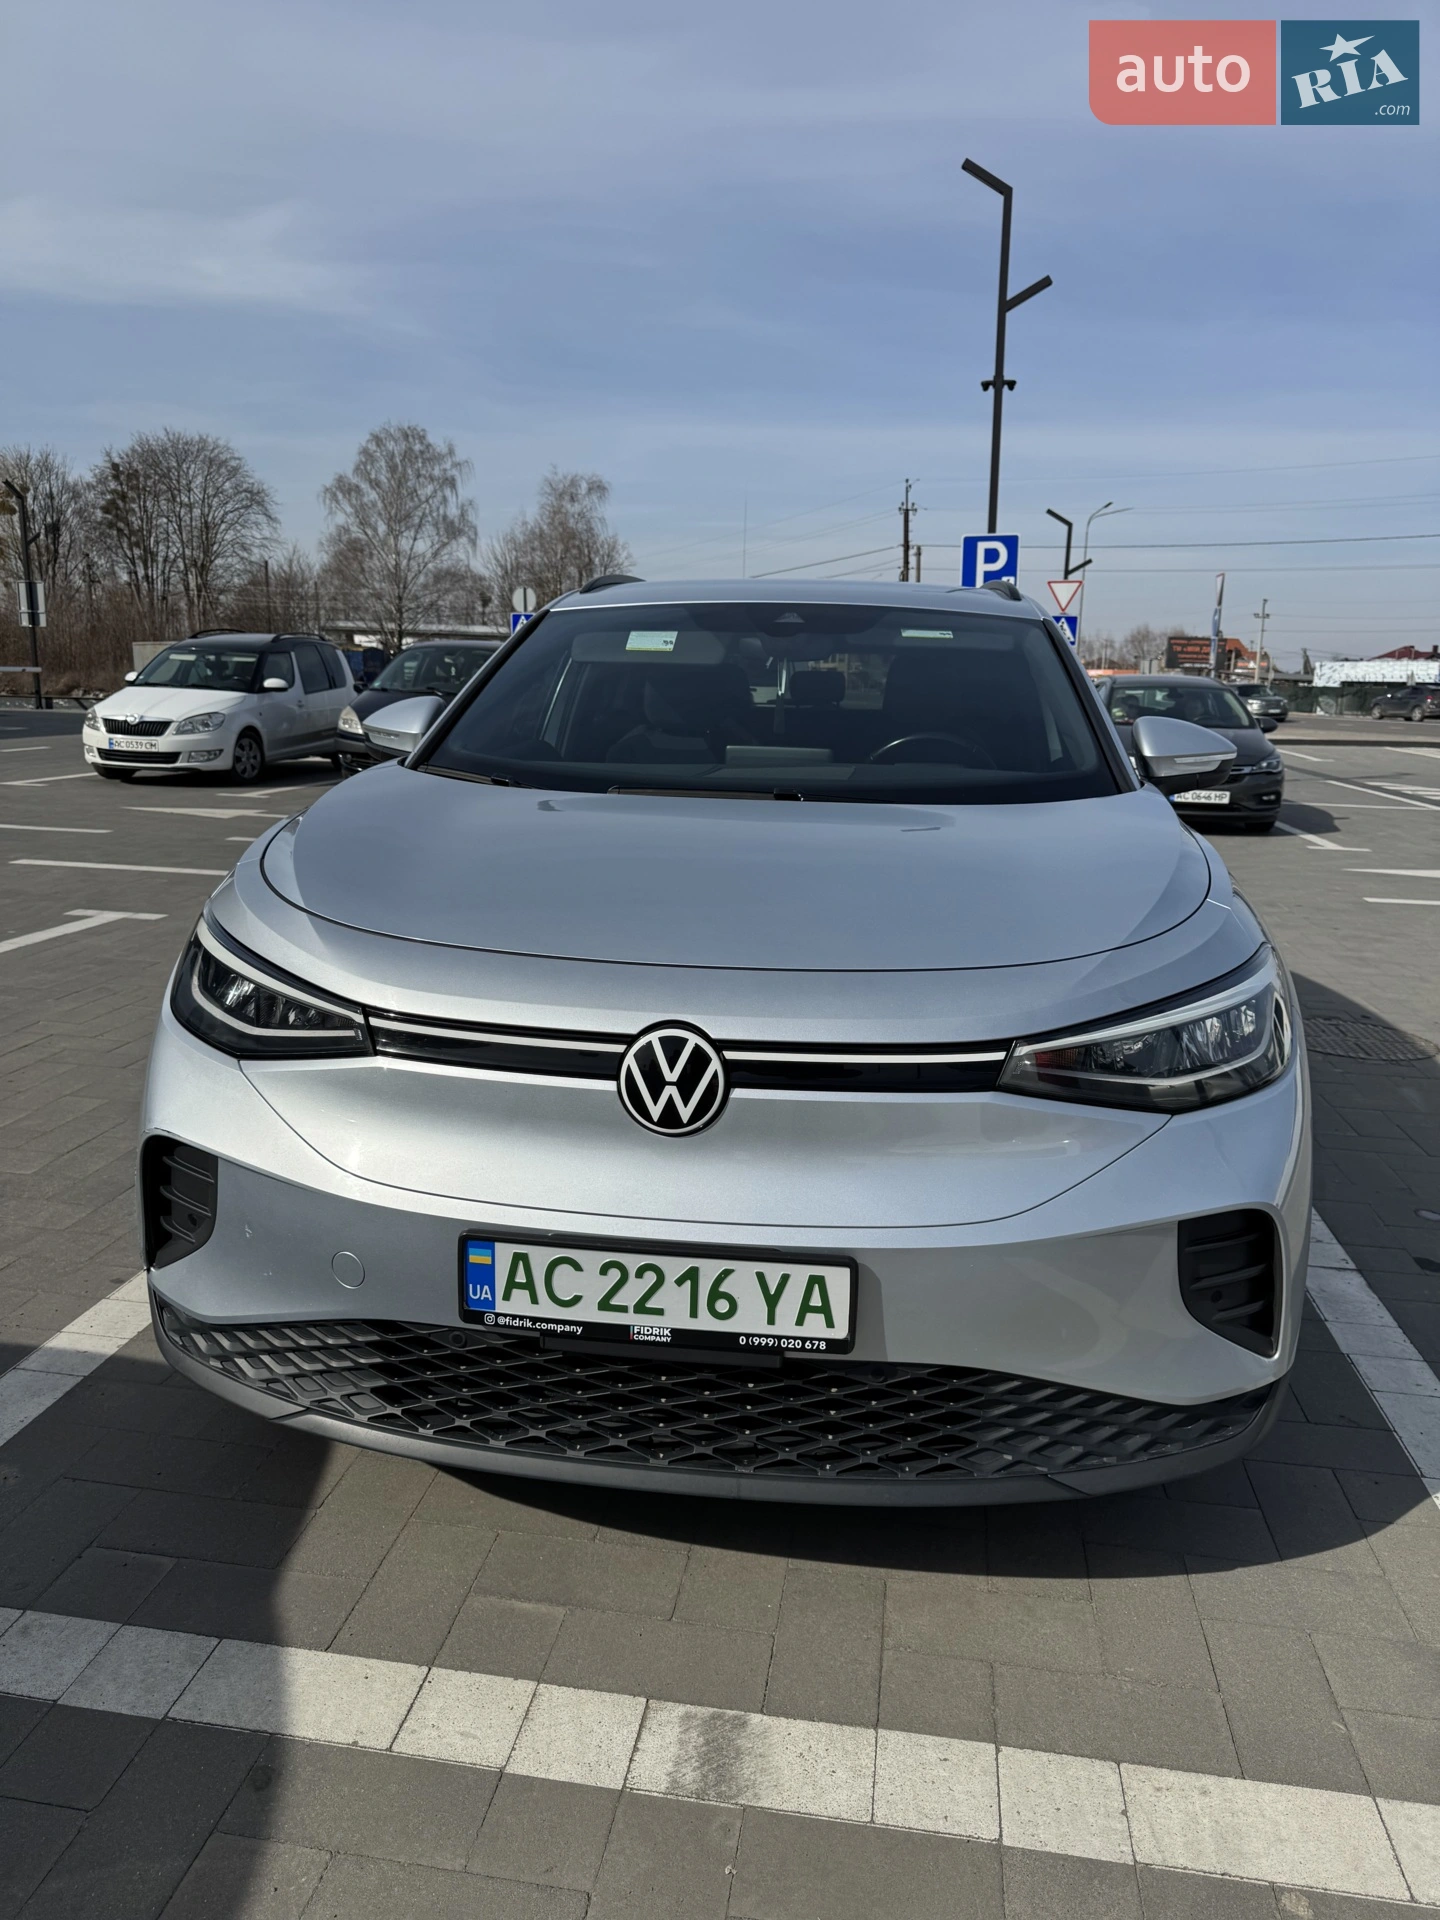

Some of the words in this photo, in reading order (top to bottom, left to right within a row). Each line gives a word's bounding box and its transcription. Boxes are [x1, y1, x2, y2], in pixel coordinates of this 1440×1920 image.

[975, 540, 1008, 588] P
[114, 740, 125, 749] AC
[125, 740, 144, 749] 0539
[144, 741, 157, 750] CM
[1191, 791, 1212, 801] 0646
[468, 1283, 493, 1301] UA
[502, 1251, 585, 1308] AC
[597, 1259, 738, 1321] 2216
[754, 1269, 835, 1329] YA
[497, 1315, 583, 1335] @fidrik.company
[633, 1325, 672, 1337] FIDRIK
[633, 1334, 672, 1343] COMPANY
[739, 1335, 747, 1345] 0
[748, 1336, 778, 1347] (999)
[780, 1338, 802, 1349] 020
[804, 1340, 827, 1350] 678
